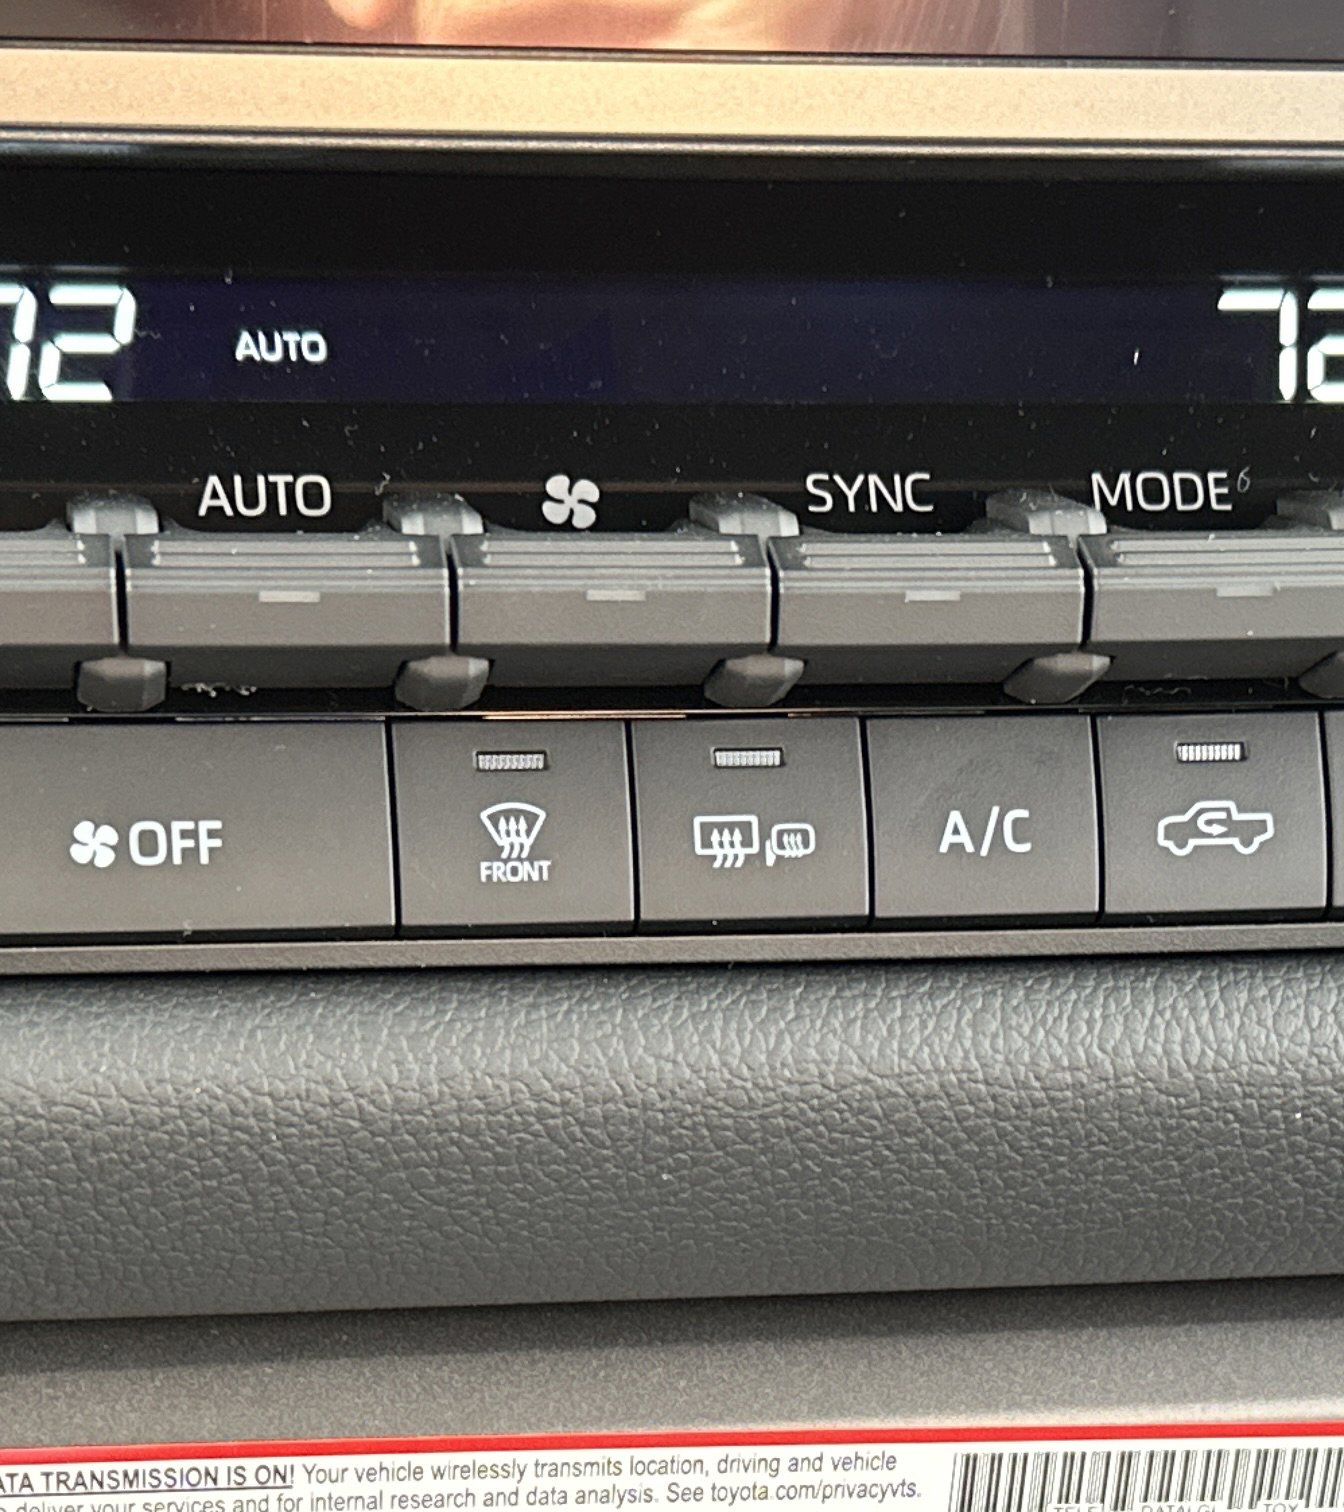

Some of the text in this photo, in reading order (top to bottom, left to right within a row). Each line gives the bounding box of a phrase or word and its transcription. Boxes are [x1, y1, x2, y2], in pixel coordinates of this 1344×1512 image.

[235, 331, 328, 363] AUTO
[198, 474, 332, 518] AUTO
[805, 472, 935, 513] SYNC
[1090, 470, 1234, 513] MODE
[128, 820, 224, 866] OFF
[939, 806, 1033, 857] A/C
[479, 860, 552, 883] FRONT
[39, 1465, 219, 1493] TRANSMISSION
[226, 1465, 248, 1486] IS
[253, 1463, 294, 1486] ON!
[302, 1463, 349, 1485] Your
[354, 1460, 424, 1484] vehicle
[430, 1456, 528, 1485] wirelessly
[533, 1455, 623, 1479] transmits
[629, 1454, 709, 1478] location,
[717, 1453, 781, 1478] driving
[787, 1452, 824, 1473] and
[830, 1450, 898, 1472] vehicle
[310, 1490, 384, 1512] internal
[390, 1488, 477, 1511] research
[482, 1486, 519, 1507] and
[525, 1485, 569, 1507] data
[574, 1481, 660, 1509] analysis.
[666, 1481, 705, 1504] See
